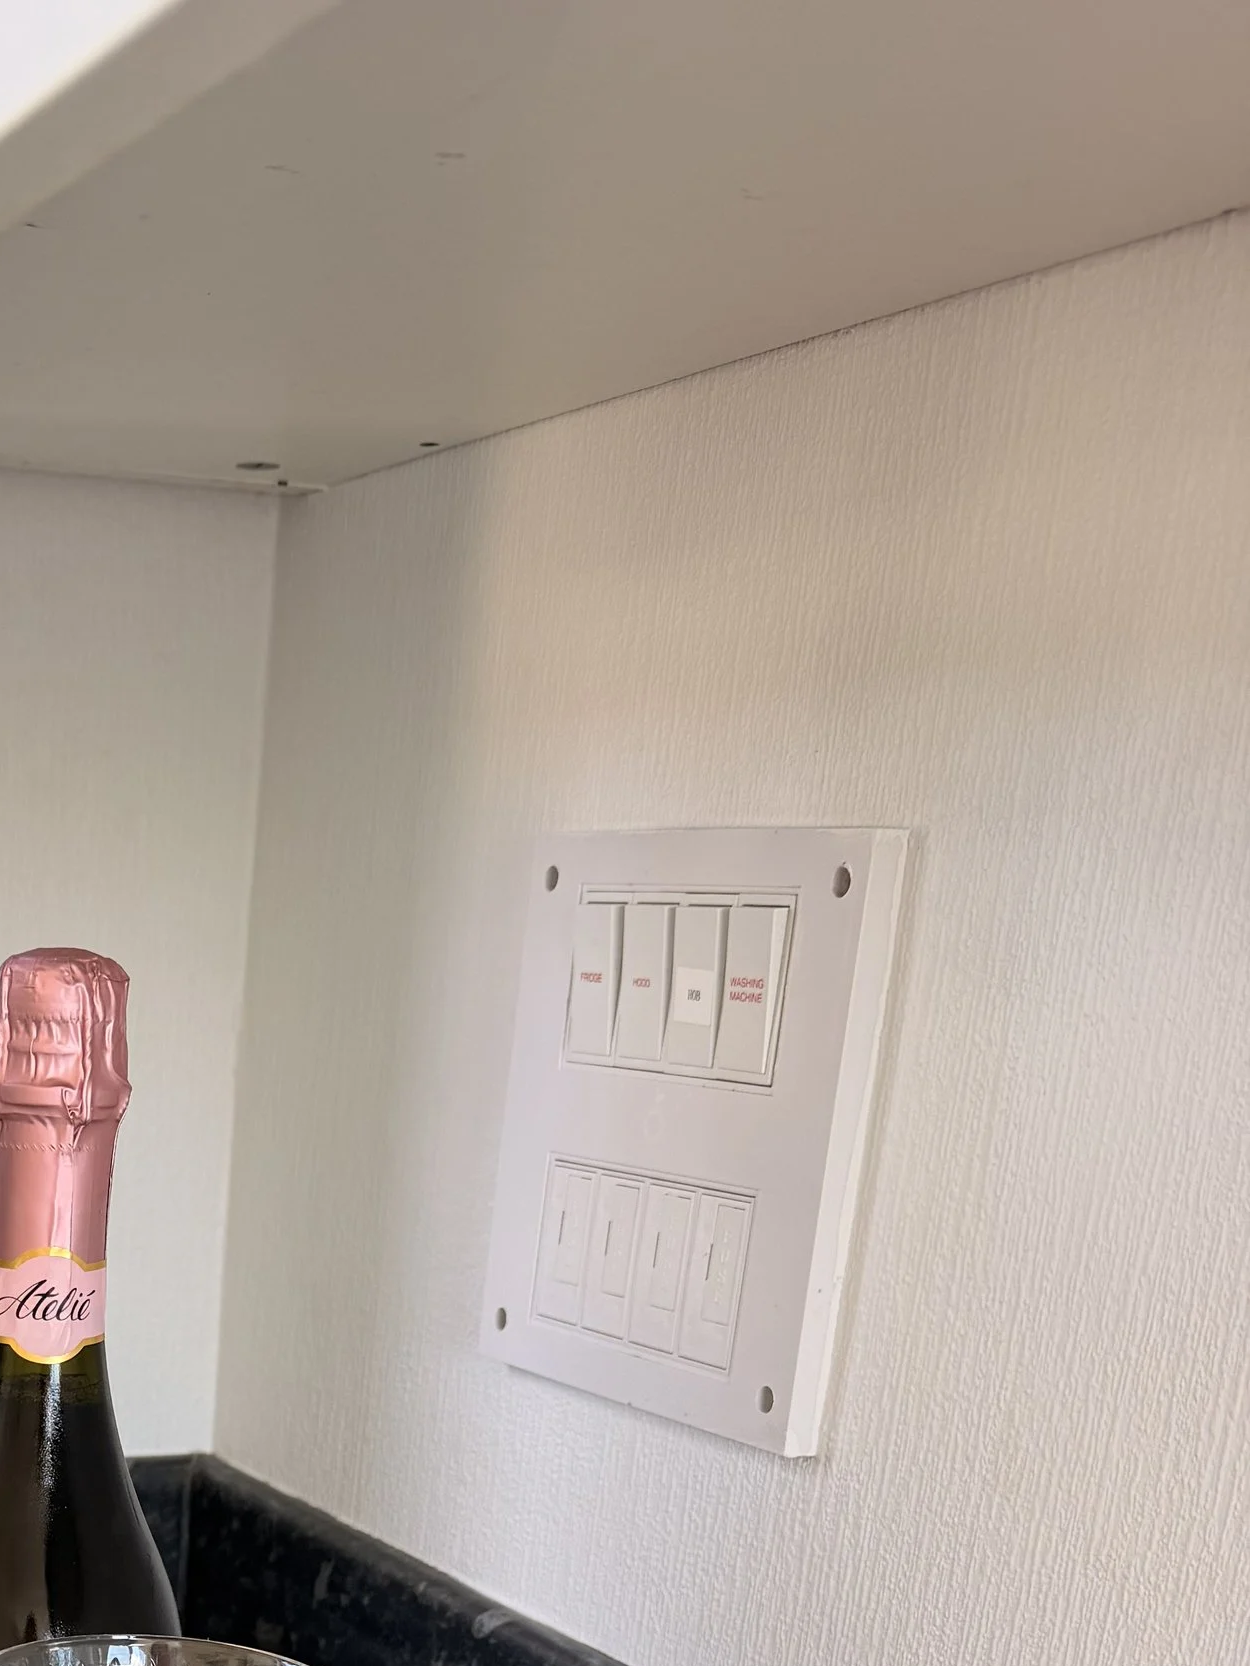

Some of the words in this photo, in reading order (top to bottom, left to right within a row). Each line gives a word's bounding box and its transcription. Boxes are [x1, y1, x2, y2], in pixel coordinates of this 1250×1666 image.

[580, 972, 603, 984] FRIDGE
[632, 977, 651, 988] HOOD
[729, 977, 765, 990] WASHING
[729, 991, 763, 1004] MACHINE
